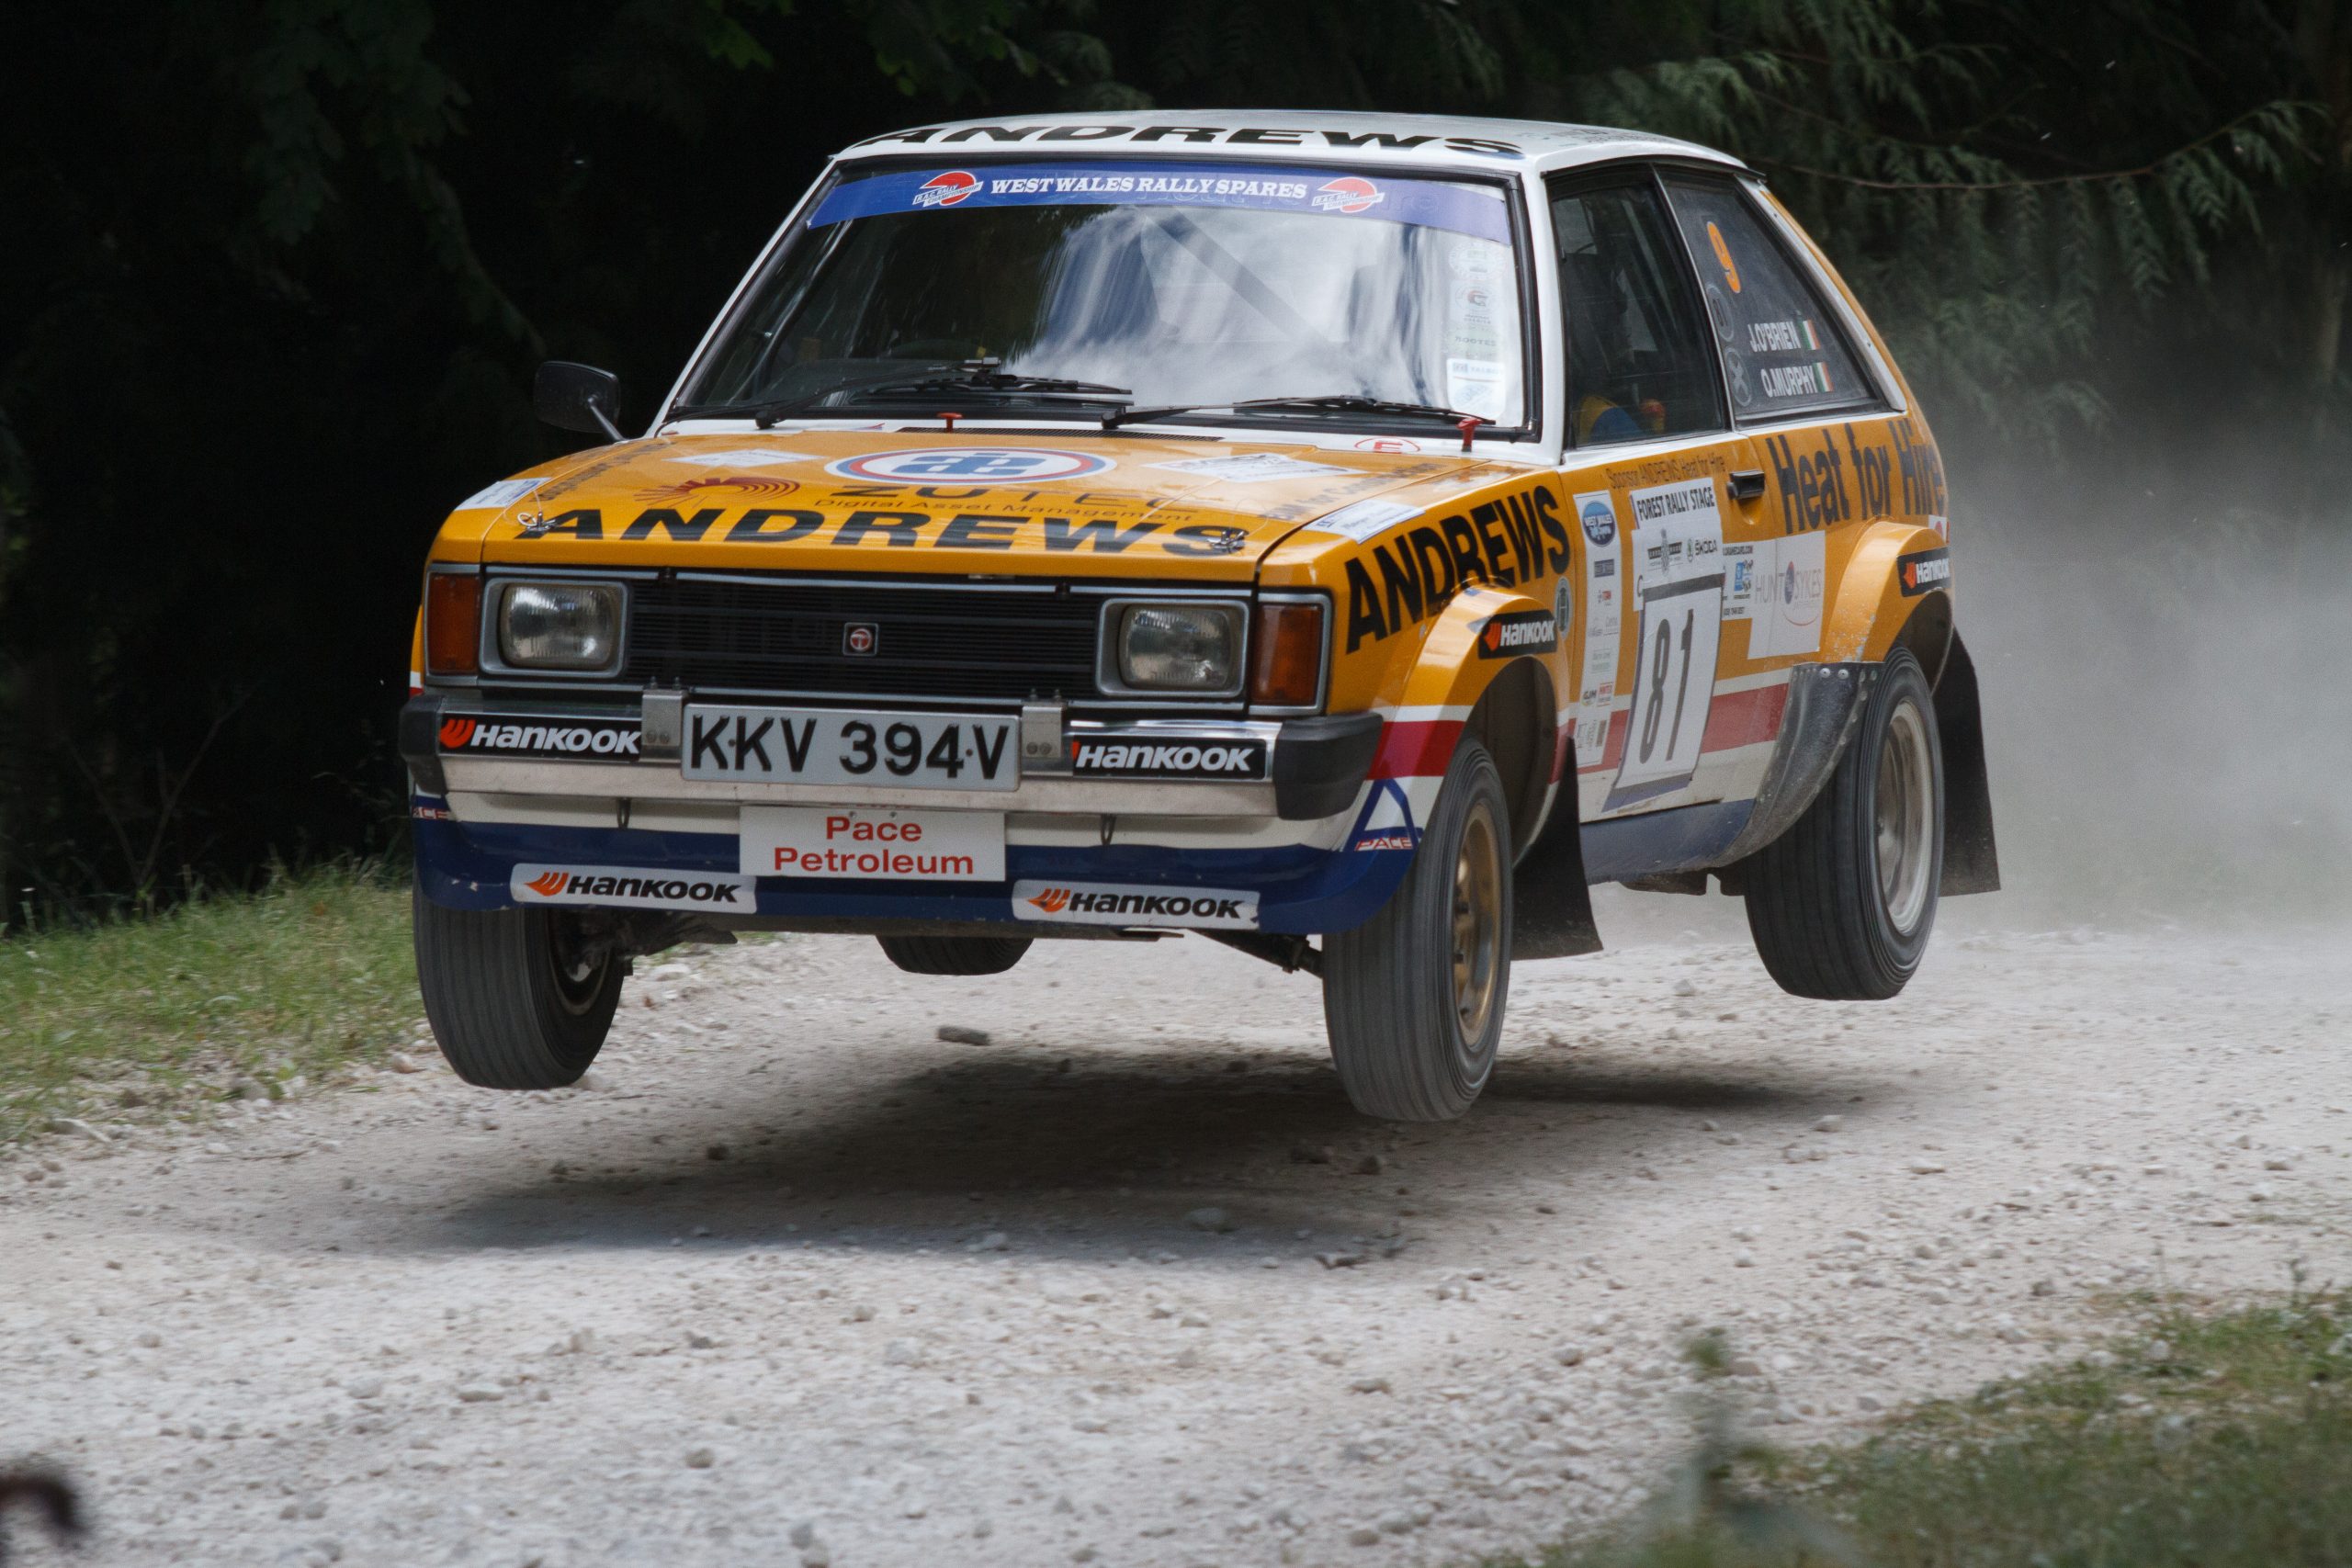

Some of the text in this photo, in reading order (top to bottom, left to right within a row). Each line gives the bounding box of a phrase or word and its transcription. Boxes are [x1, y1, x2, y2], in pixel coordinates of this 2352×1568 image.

[853, 125, 1527, 161] ANDREWS
[991, 177, 1054, 194] WEST
[1052, 176, 1135, 193] WALES
[1137, 176, 1218, 195] RALLY
[1214, 178, 1307, 199] SPARES
[1747, 321, 1801, 352] J.O'BRIEN
[1760, 366, 1818, 398] O.MURPHY
[1765, 428, 1850, 535] Heat
[1845, 423, 1892, 520] for
[814, 498, 1193, 523] Digital Asset Management
[831, 484, 1200, 513] ZUTEC
[1636, 486, 1715, 522] FOREST RALLY STAGE
[514, 508, 1250, 558] ANDREWS
[1694, 539, 1718, 556] ŠKODA
[1344, 485, 1571, 655] ANDREWS
[1639, 609, 1694, 764] 81
[691, 714, 1009, 780] KKV 394V
[826, 816, 922, 842] Pace
[1354, 837, 1413, 852] PACE
[775, 847, 974, 874] Petroleum
